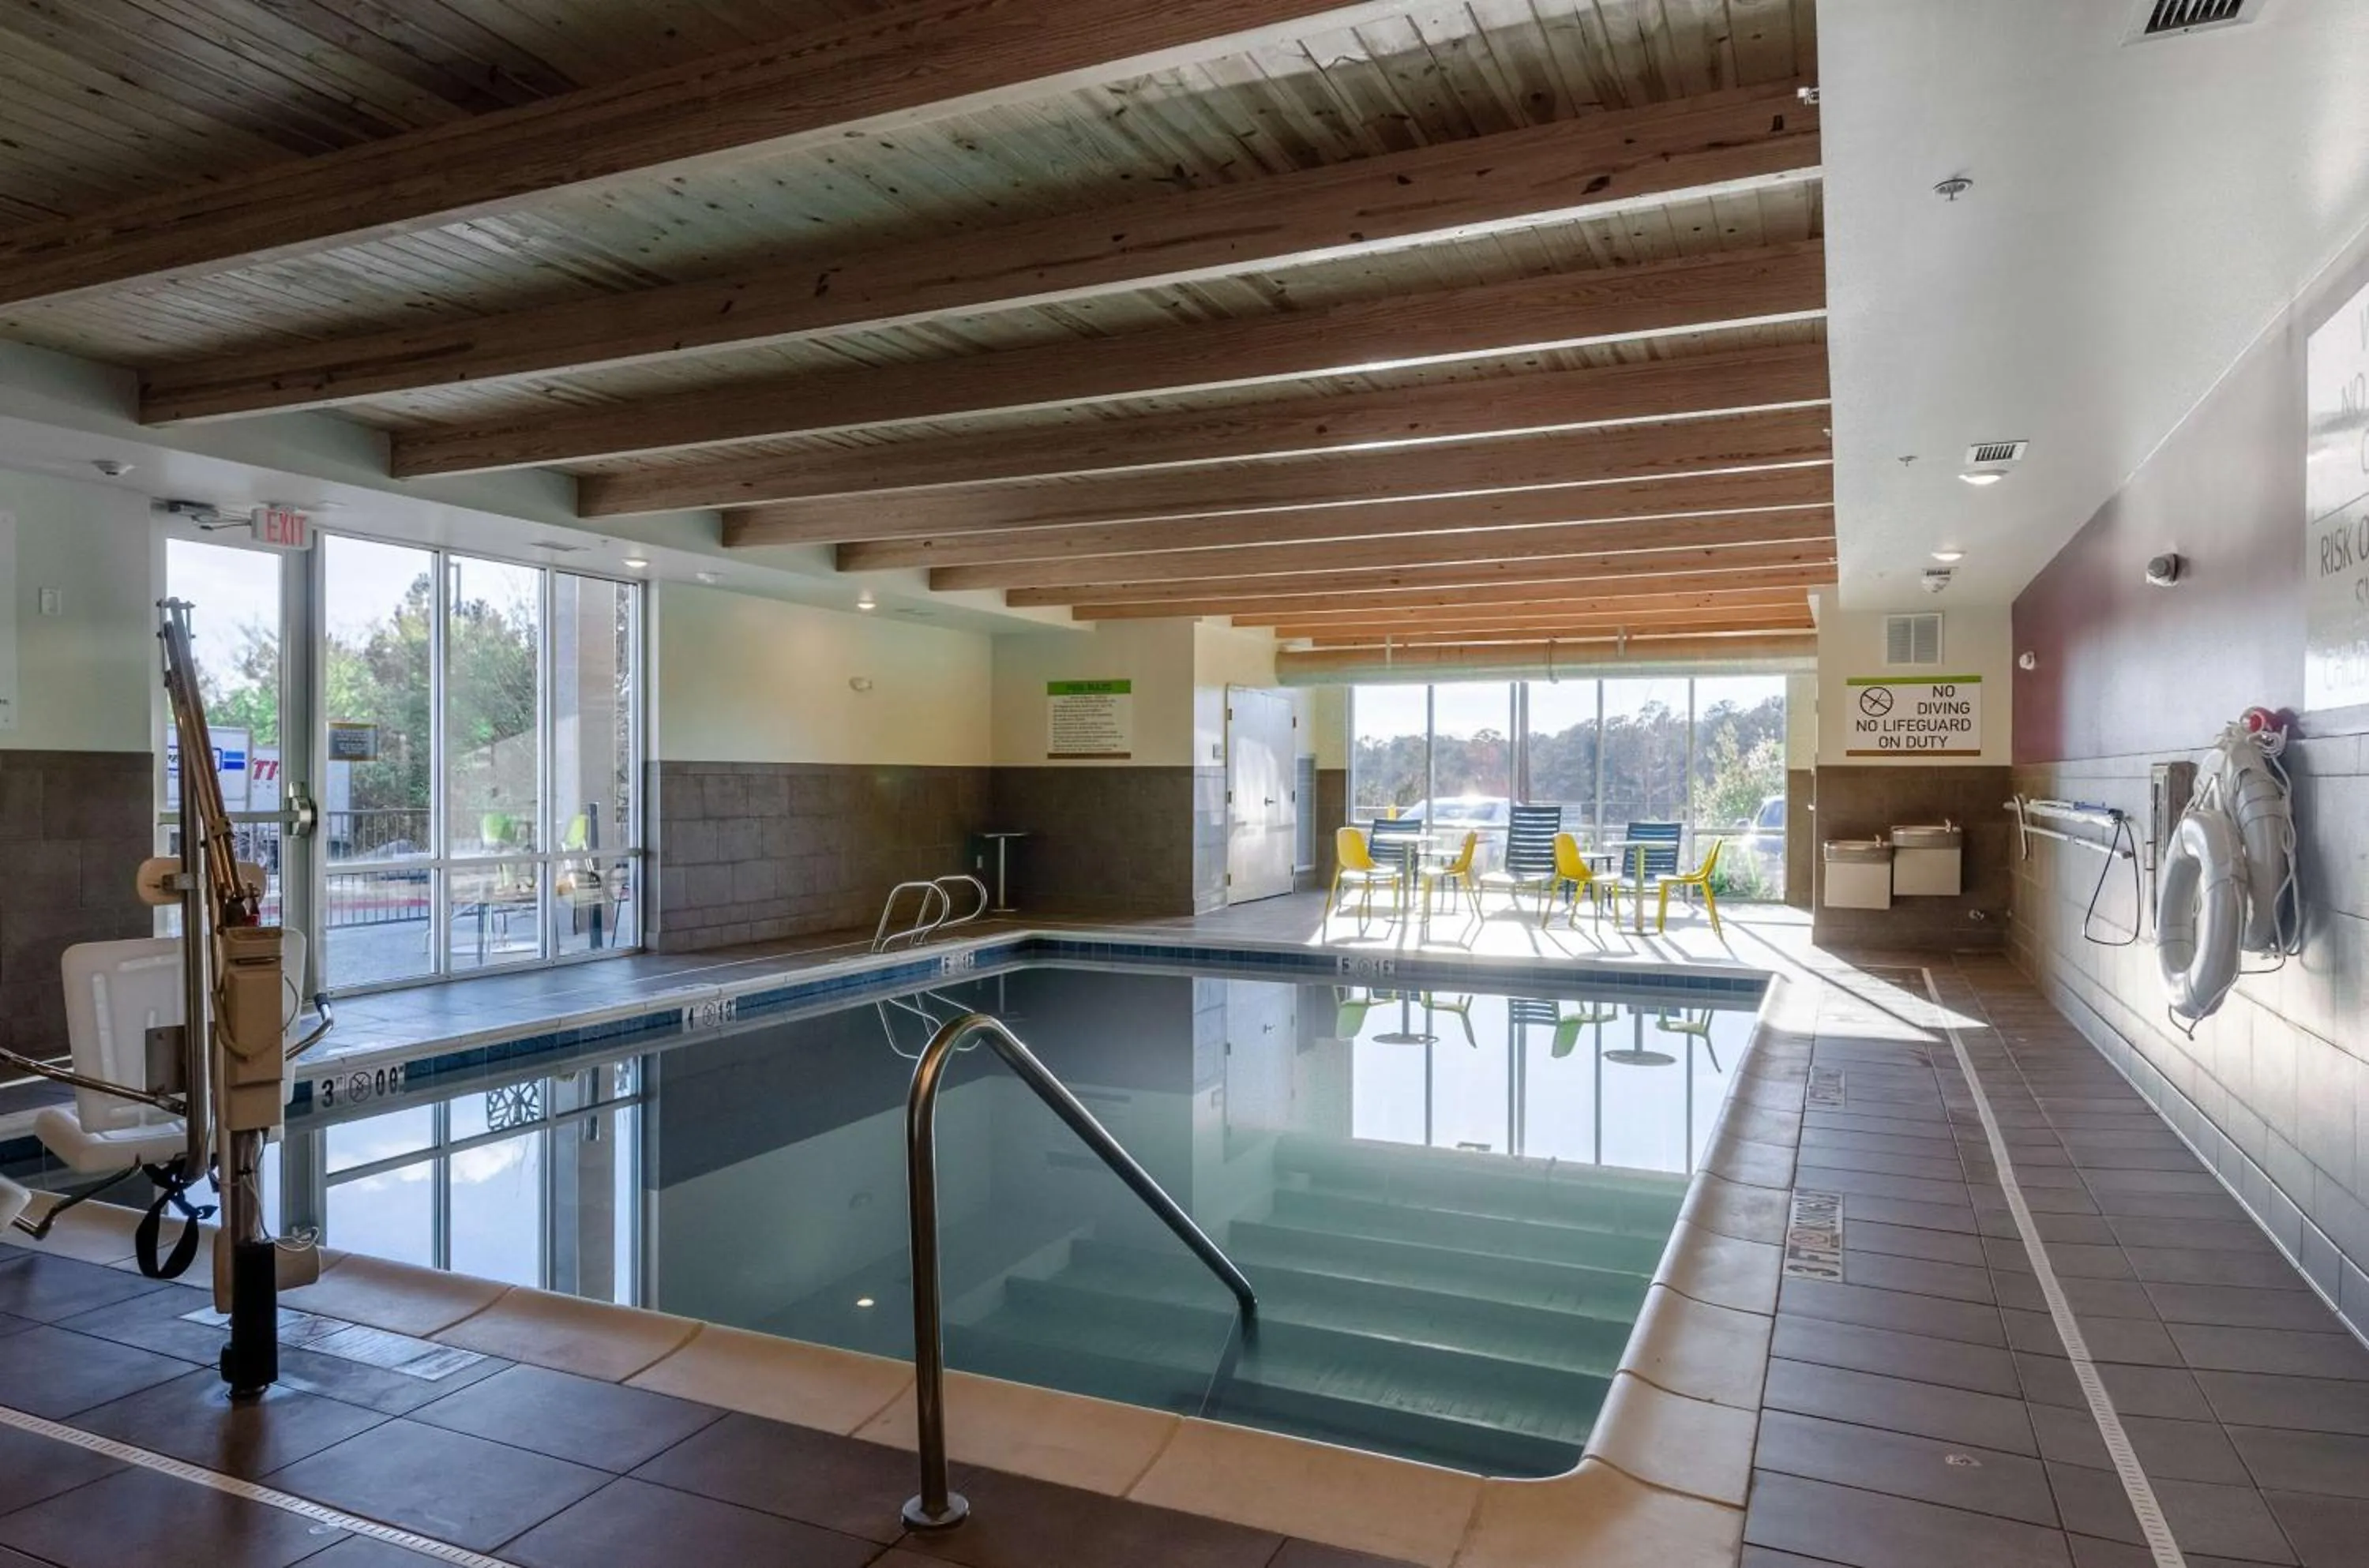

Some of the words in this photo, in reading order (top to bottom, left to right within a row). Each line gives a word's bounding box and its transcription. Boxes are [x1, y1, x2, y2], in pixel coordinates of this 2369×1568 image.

[266, 510, 306, 546] EXIT
[2320, 524, 2353, 577] RISK
[1932, 685, 1955, 697] NO
[1917, 702, 1970, 715] DIVING
[1857, 719, 1878, 732] NO
[1883, 718, 1972, 732] LIFEGUARD
[1879, 736, 1900, 748] ON
[1906, 736, 1948, 748] DUTY
